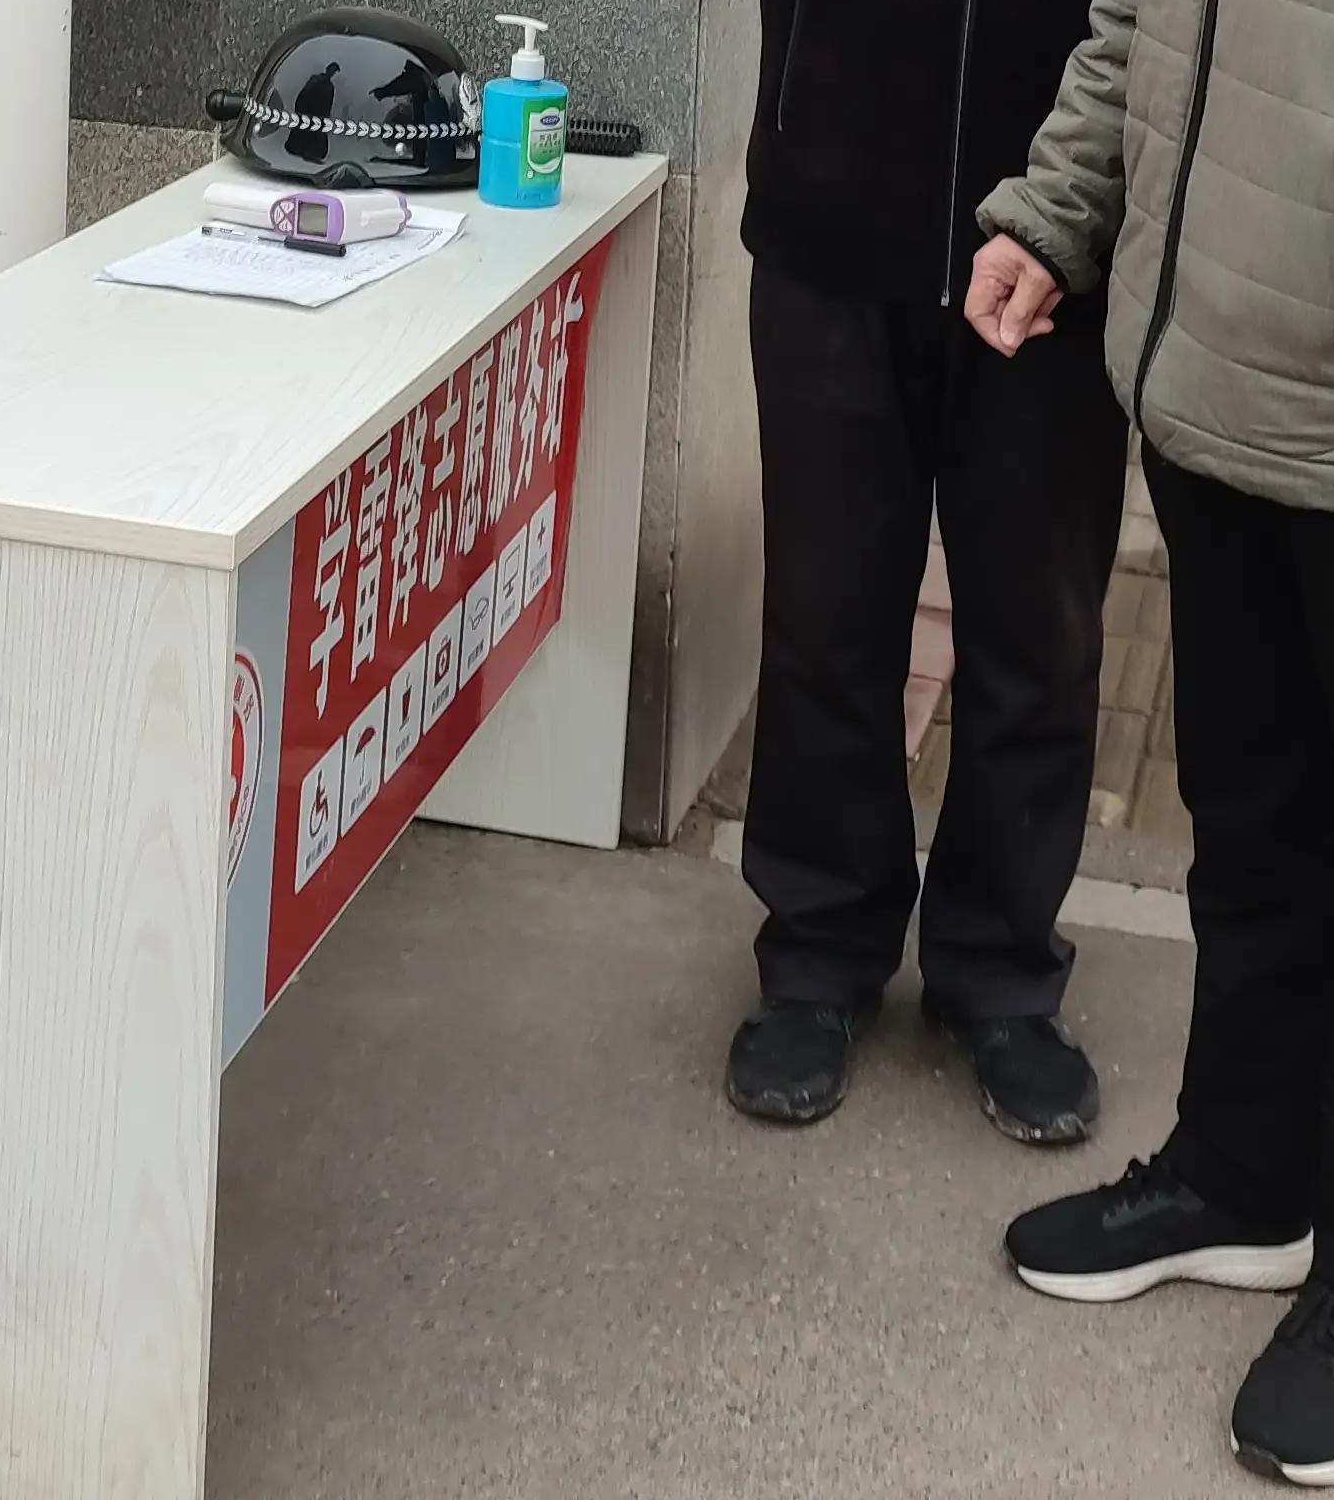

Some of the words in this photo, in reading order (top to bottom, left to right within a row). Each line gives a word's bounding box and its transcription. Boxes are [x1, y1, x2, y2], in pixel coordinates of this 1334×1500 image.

[309, 270, 585, 720] 学雷锋志愿服务站
